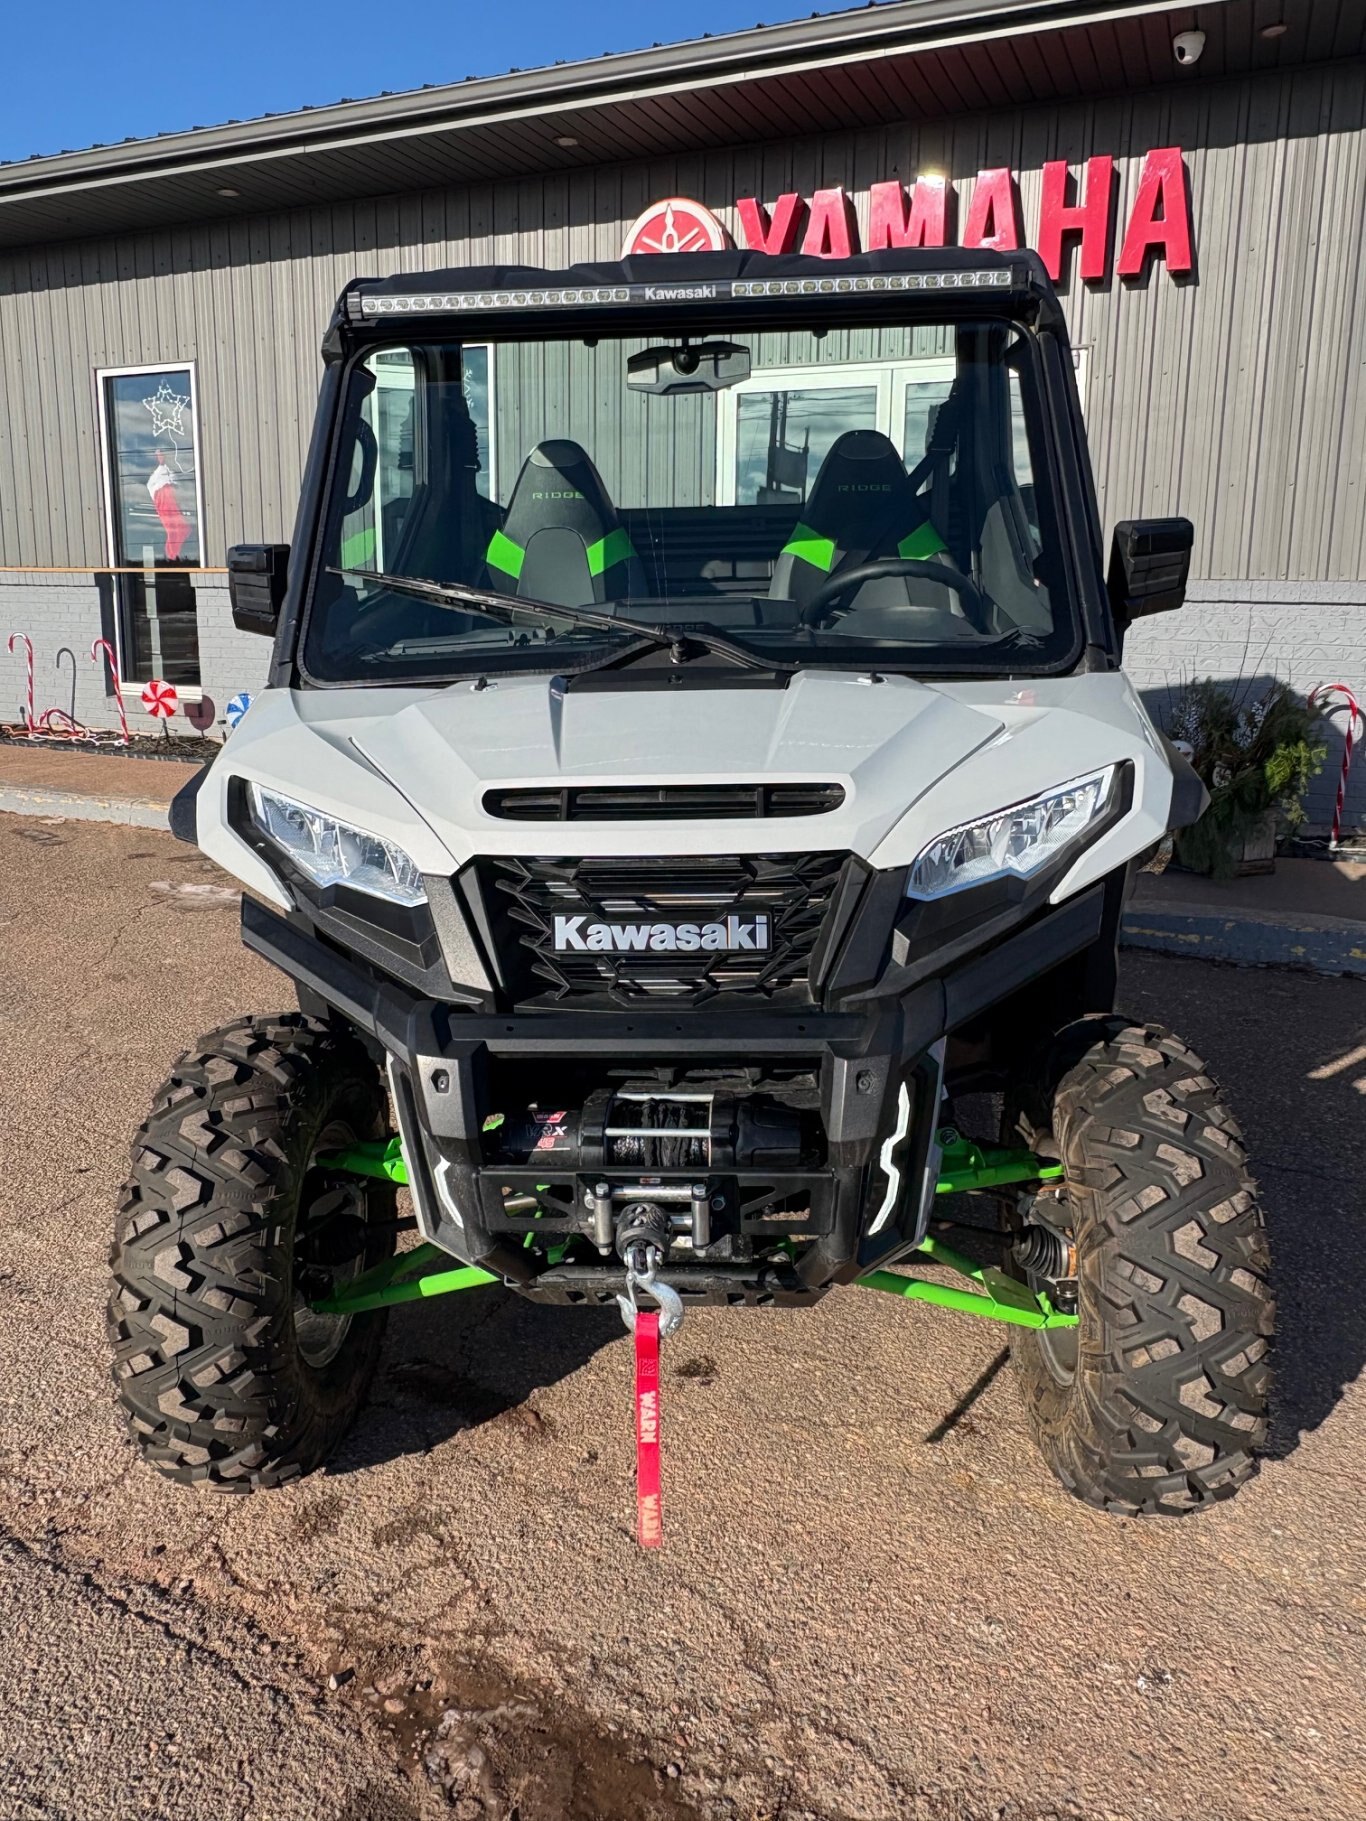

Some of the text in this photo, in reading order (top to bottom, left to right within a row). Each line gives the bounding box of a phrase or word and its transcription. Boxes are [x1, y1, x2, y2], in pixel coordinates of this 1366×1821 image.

[737, 146, 1192, 281] YAMAHA
[645, 285, 717, 301] Kawasaki
[532, 491, 586, 500] RIDGE
[554, 915, 768, 951] Kawasaki
[639, 1390, 657, 1443] WARN
[641, 1493, 660, 1540] WARN
